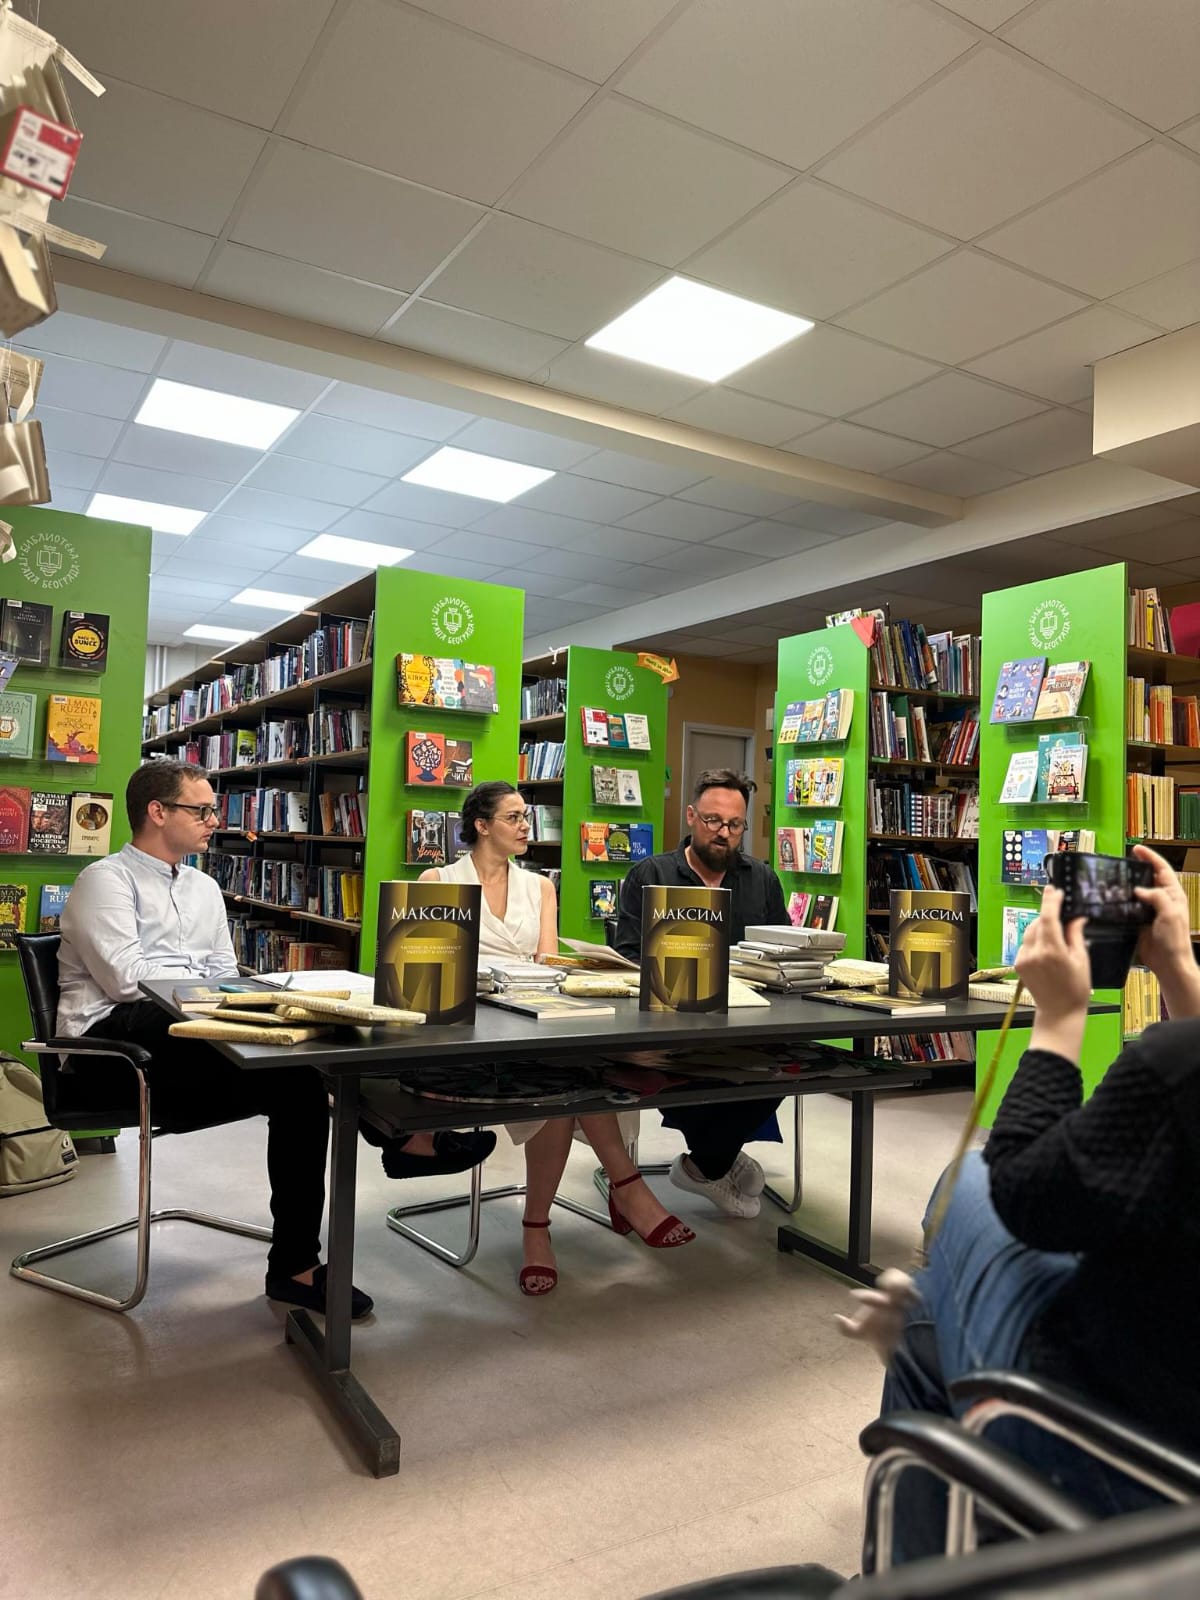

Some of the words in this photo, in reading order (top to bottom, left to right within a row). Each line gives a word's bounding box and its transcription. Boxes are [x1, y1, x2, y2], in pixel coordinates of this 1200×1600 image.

[20, 533, 79, 560] БИБЛИОТЕКА
[19, 557, 40, 584] ГРАДА
[42, 565, 80, 589] БЕОГРАДА
[432, 597, 474, 620] БИБЛИОТЕКА
[1029, 600, 1070, 624] БИБЛИОТЕКА
[391, 906, 472, 921] МАКСИМ
[652, 907, 724, 922] МАКСИМ
[899, 908, 964, 921] МАКСИМ
